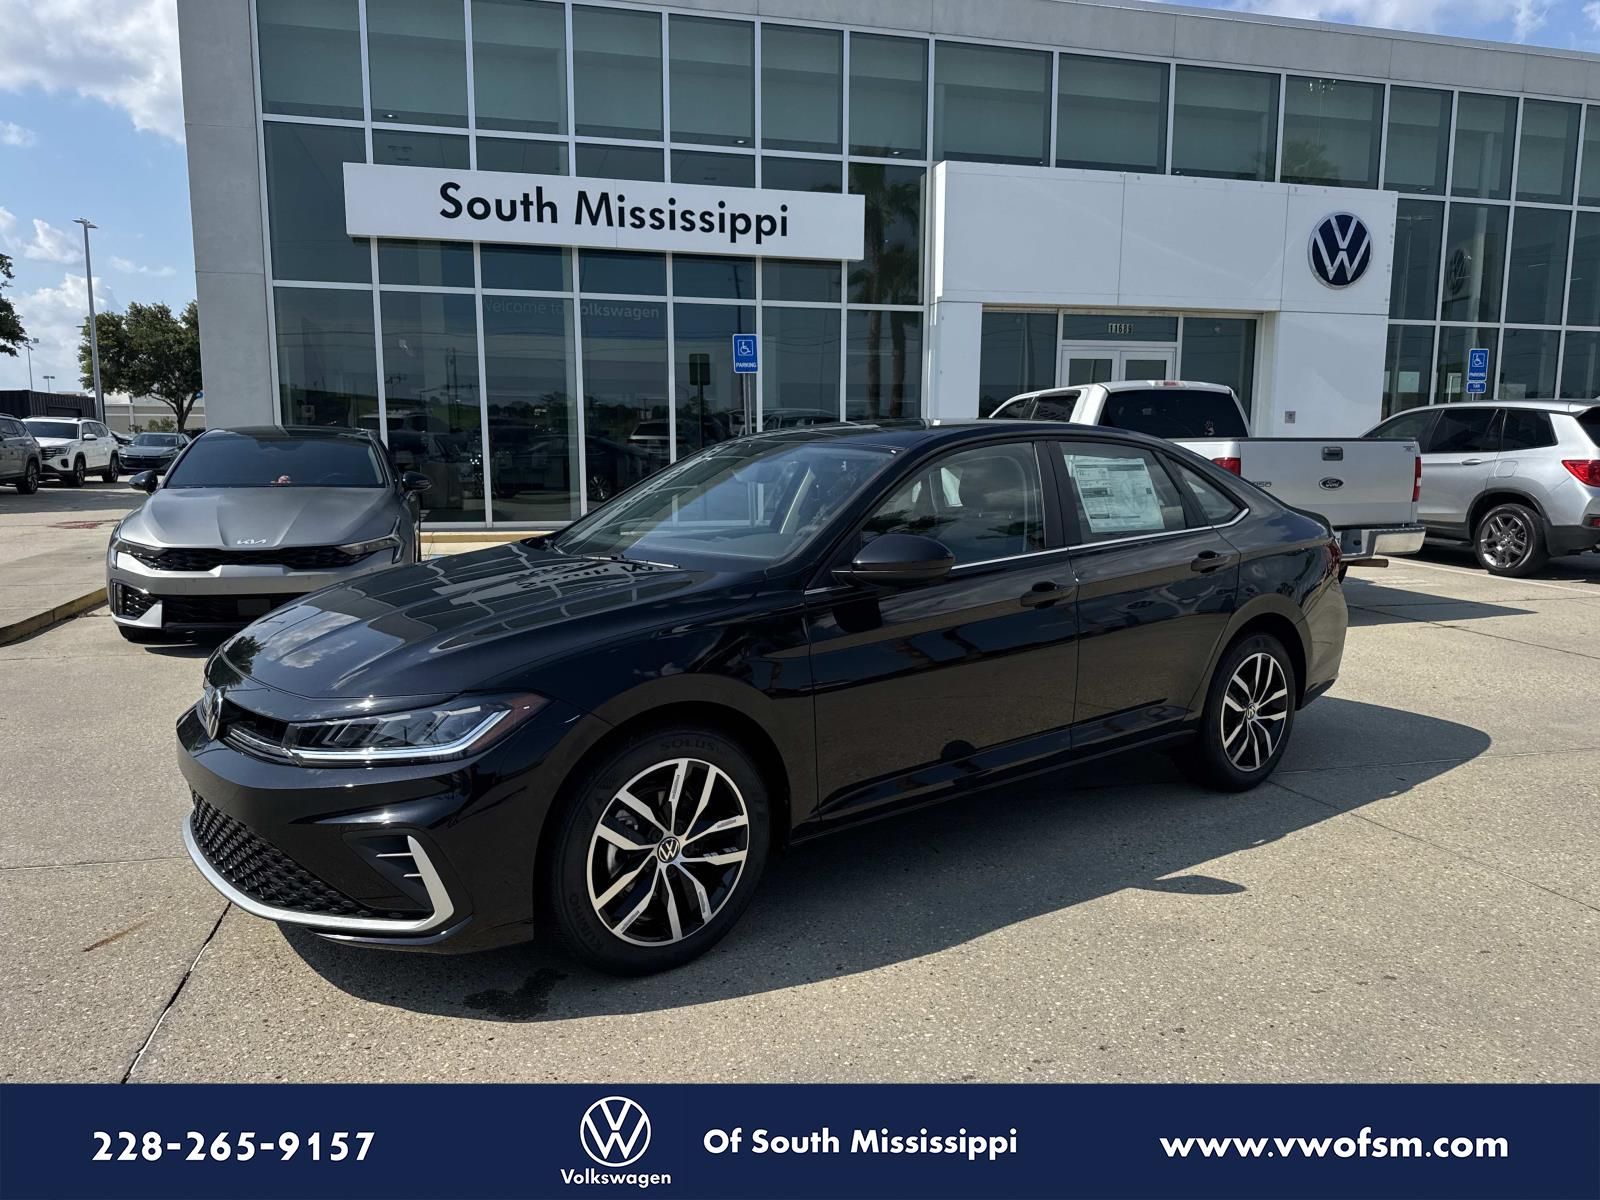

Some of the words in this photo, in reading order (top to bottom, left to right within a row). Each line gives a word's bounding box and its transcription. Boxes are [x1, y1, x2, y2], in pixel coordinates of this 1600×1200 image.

[440, 181, 558, 224] South
[574, 189, 789, 244] Mississippi
[1310, 213, 1372, 287] VW
[581, 303, 660, 320] olkswagen
